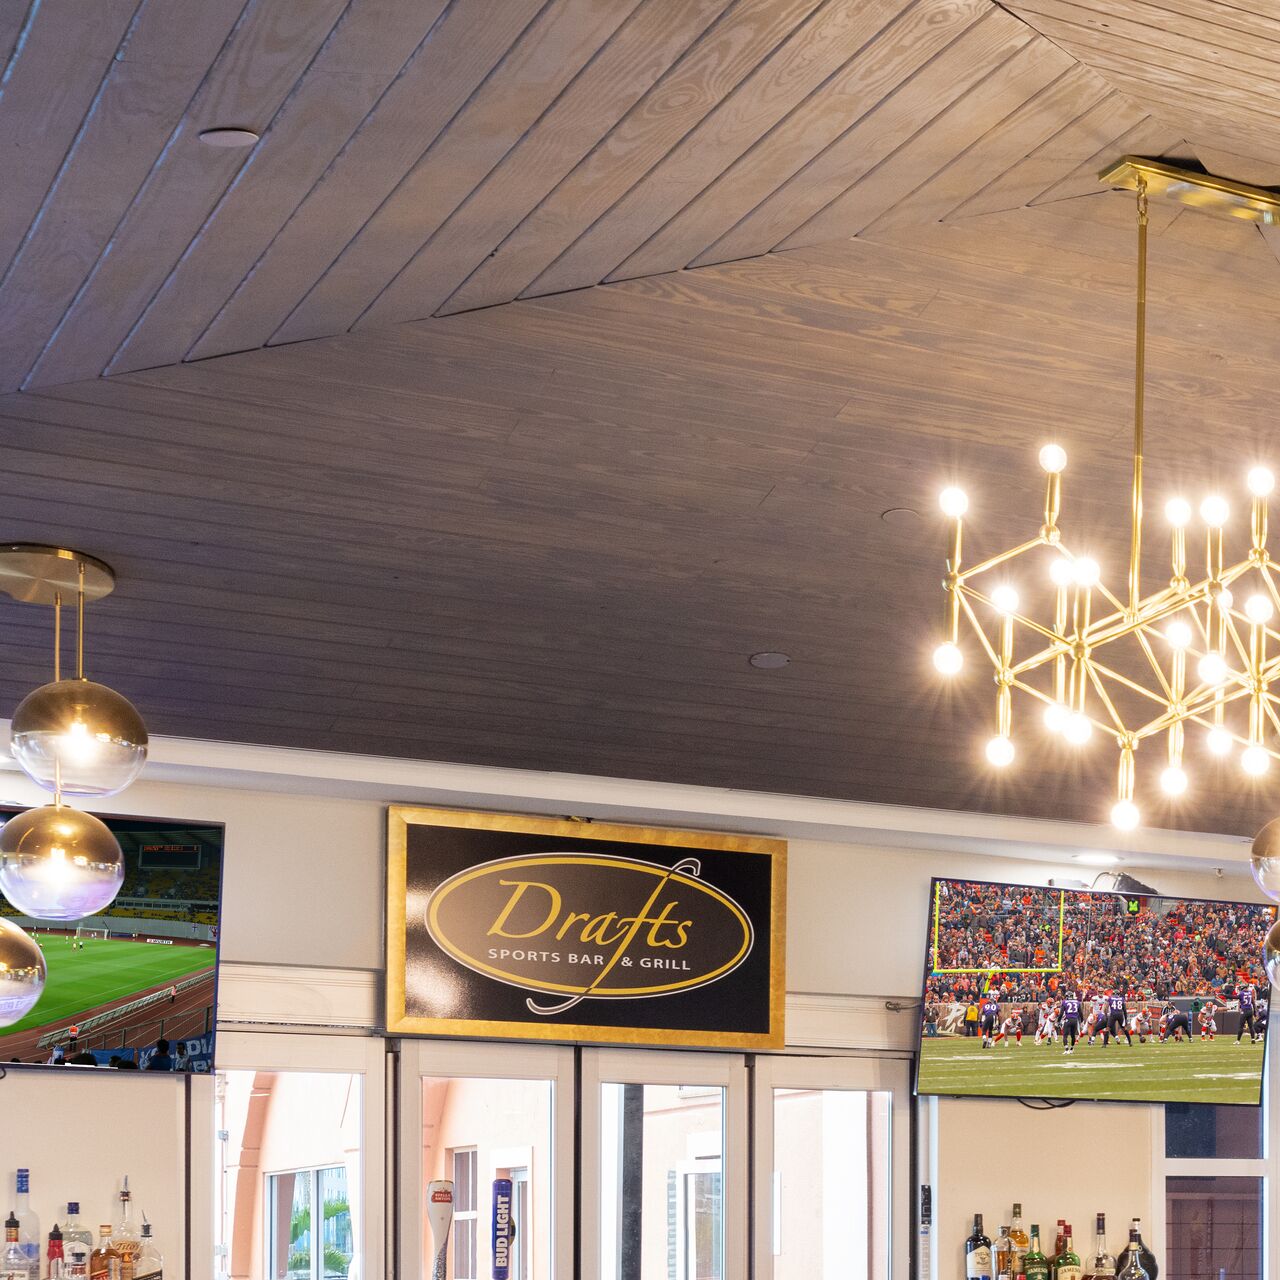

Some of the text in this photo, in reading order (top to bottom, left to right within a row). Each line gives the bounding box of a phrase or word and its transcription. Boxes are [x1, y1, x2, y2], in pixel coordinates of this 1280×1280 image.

[487, 866, 698, 996] Drafts
[488, 948, 691, 971] SPORTS BAR & GRILL
[1111, 1001, 1123, 1010] 48
[1243, 995, 1252, 1004] 57
[1067, 1003, 1078, 1013] 23
[496, 1195, 509, 1266] BUD LIGHT
